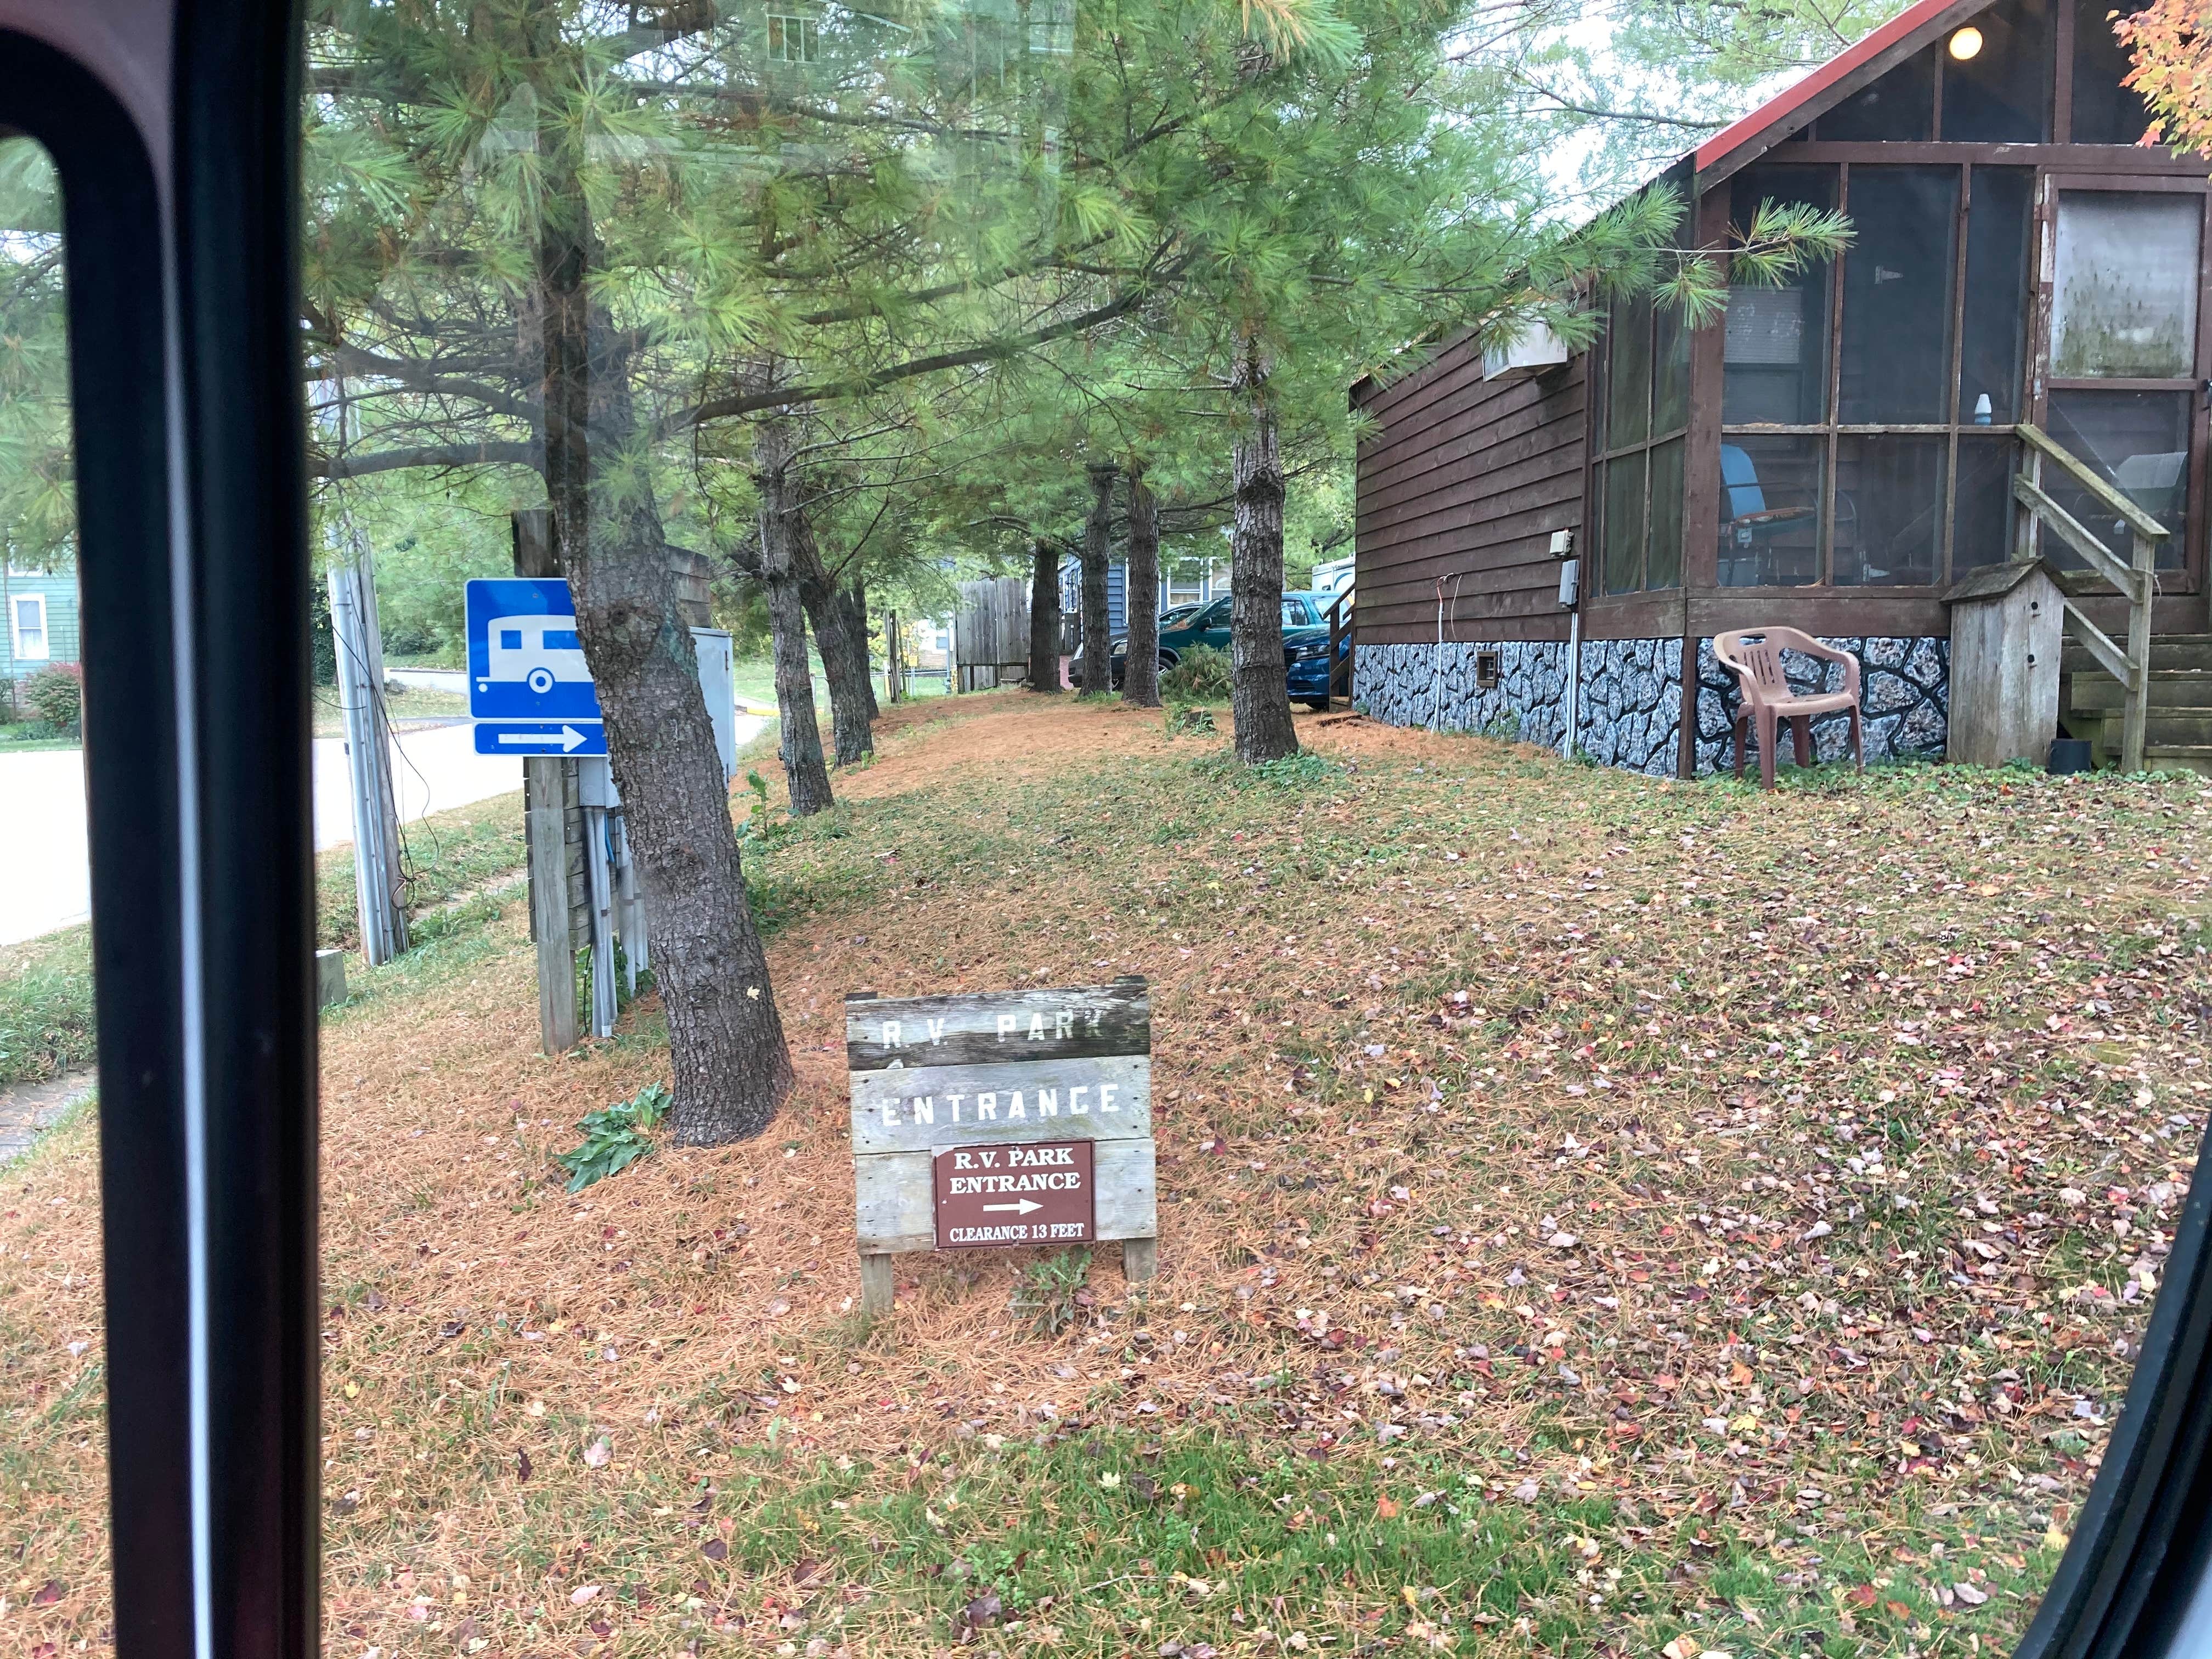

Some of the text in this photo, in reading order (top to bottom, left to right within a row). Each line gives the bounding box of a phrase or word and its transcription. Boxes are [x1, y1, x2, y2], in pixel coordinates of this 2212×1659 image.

[997, 1009, 1103, 1042] PARK
[882, 1084, 1120, 1126] ENTRANCE
[954, 1148, 1074, 1170] R.V. PARK
[950, 1172, 1081, 1194] ENTRANCE
[950, 1222, 1085, 1242] CLEARANCE 13 FEET
